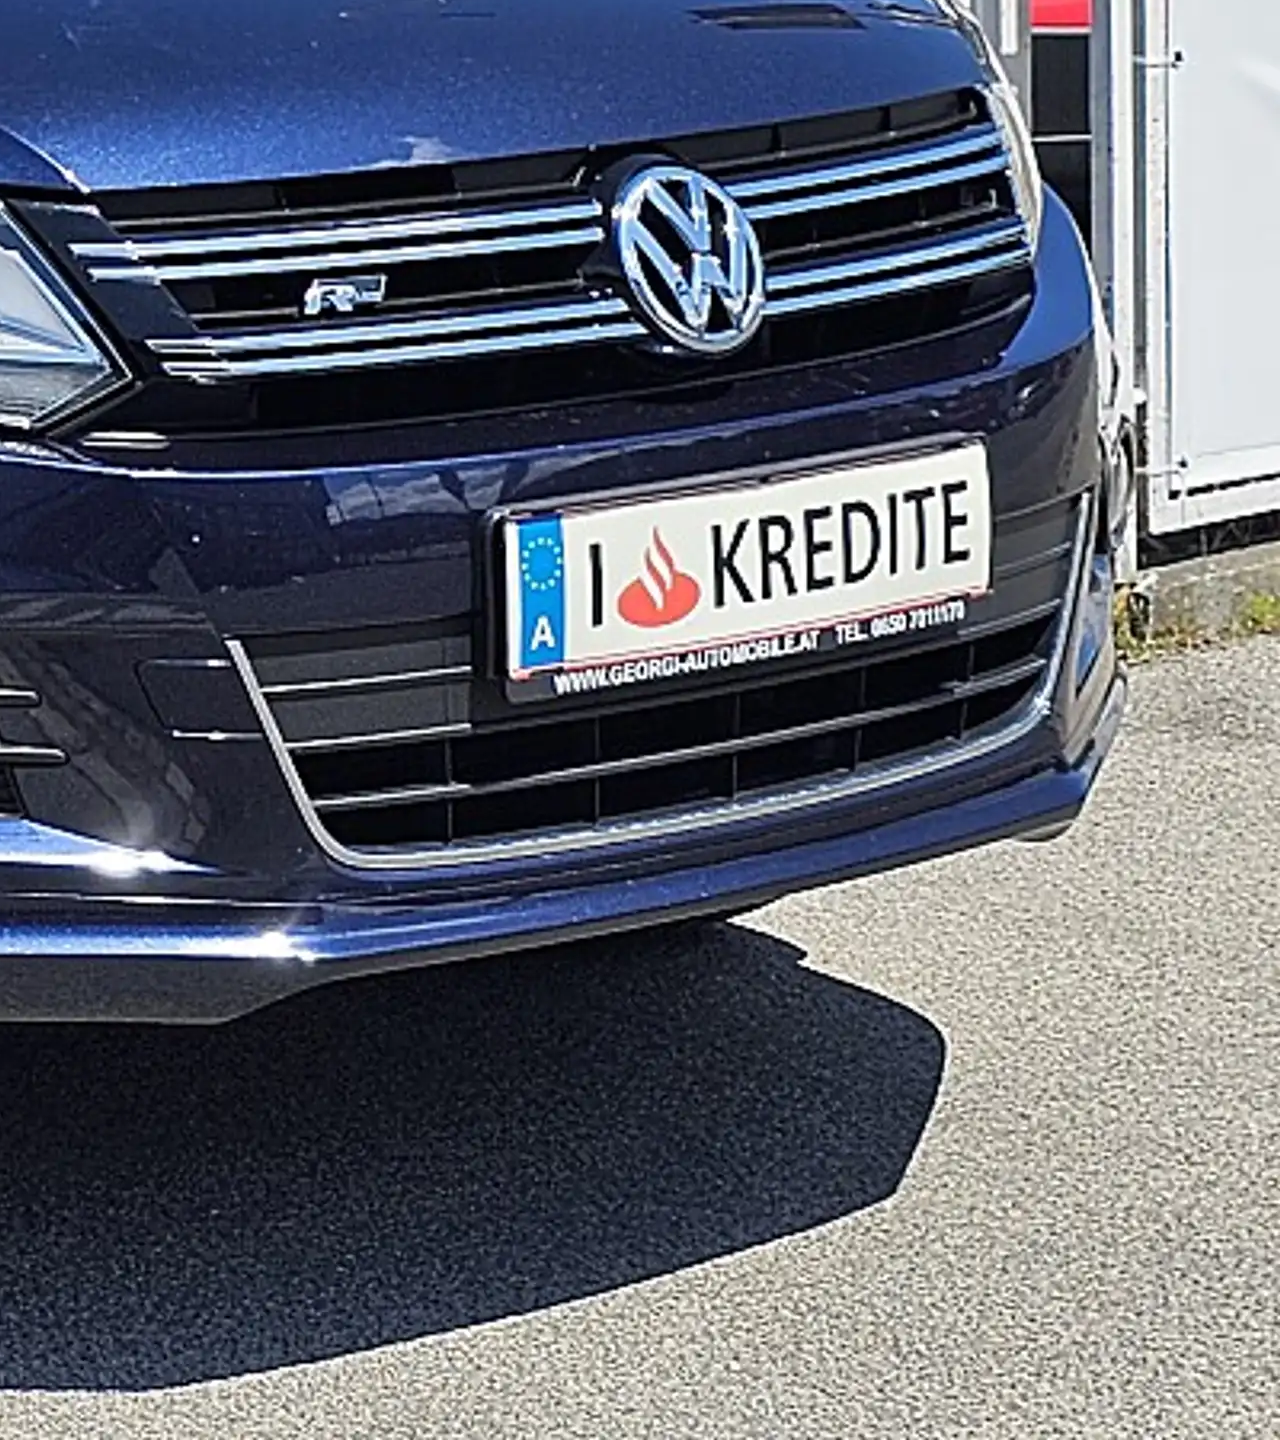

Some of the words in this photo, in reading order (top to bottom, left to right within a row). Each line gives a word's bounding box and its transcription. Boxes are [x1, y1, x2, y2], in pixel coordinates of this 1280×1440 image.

[590, 543, 603, 627] I
[711, 479, 969, 608] KREDITE
[531, 615, 556, 651] A
